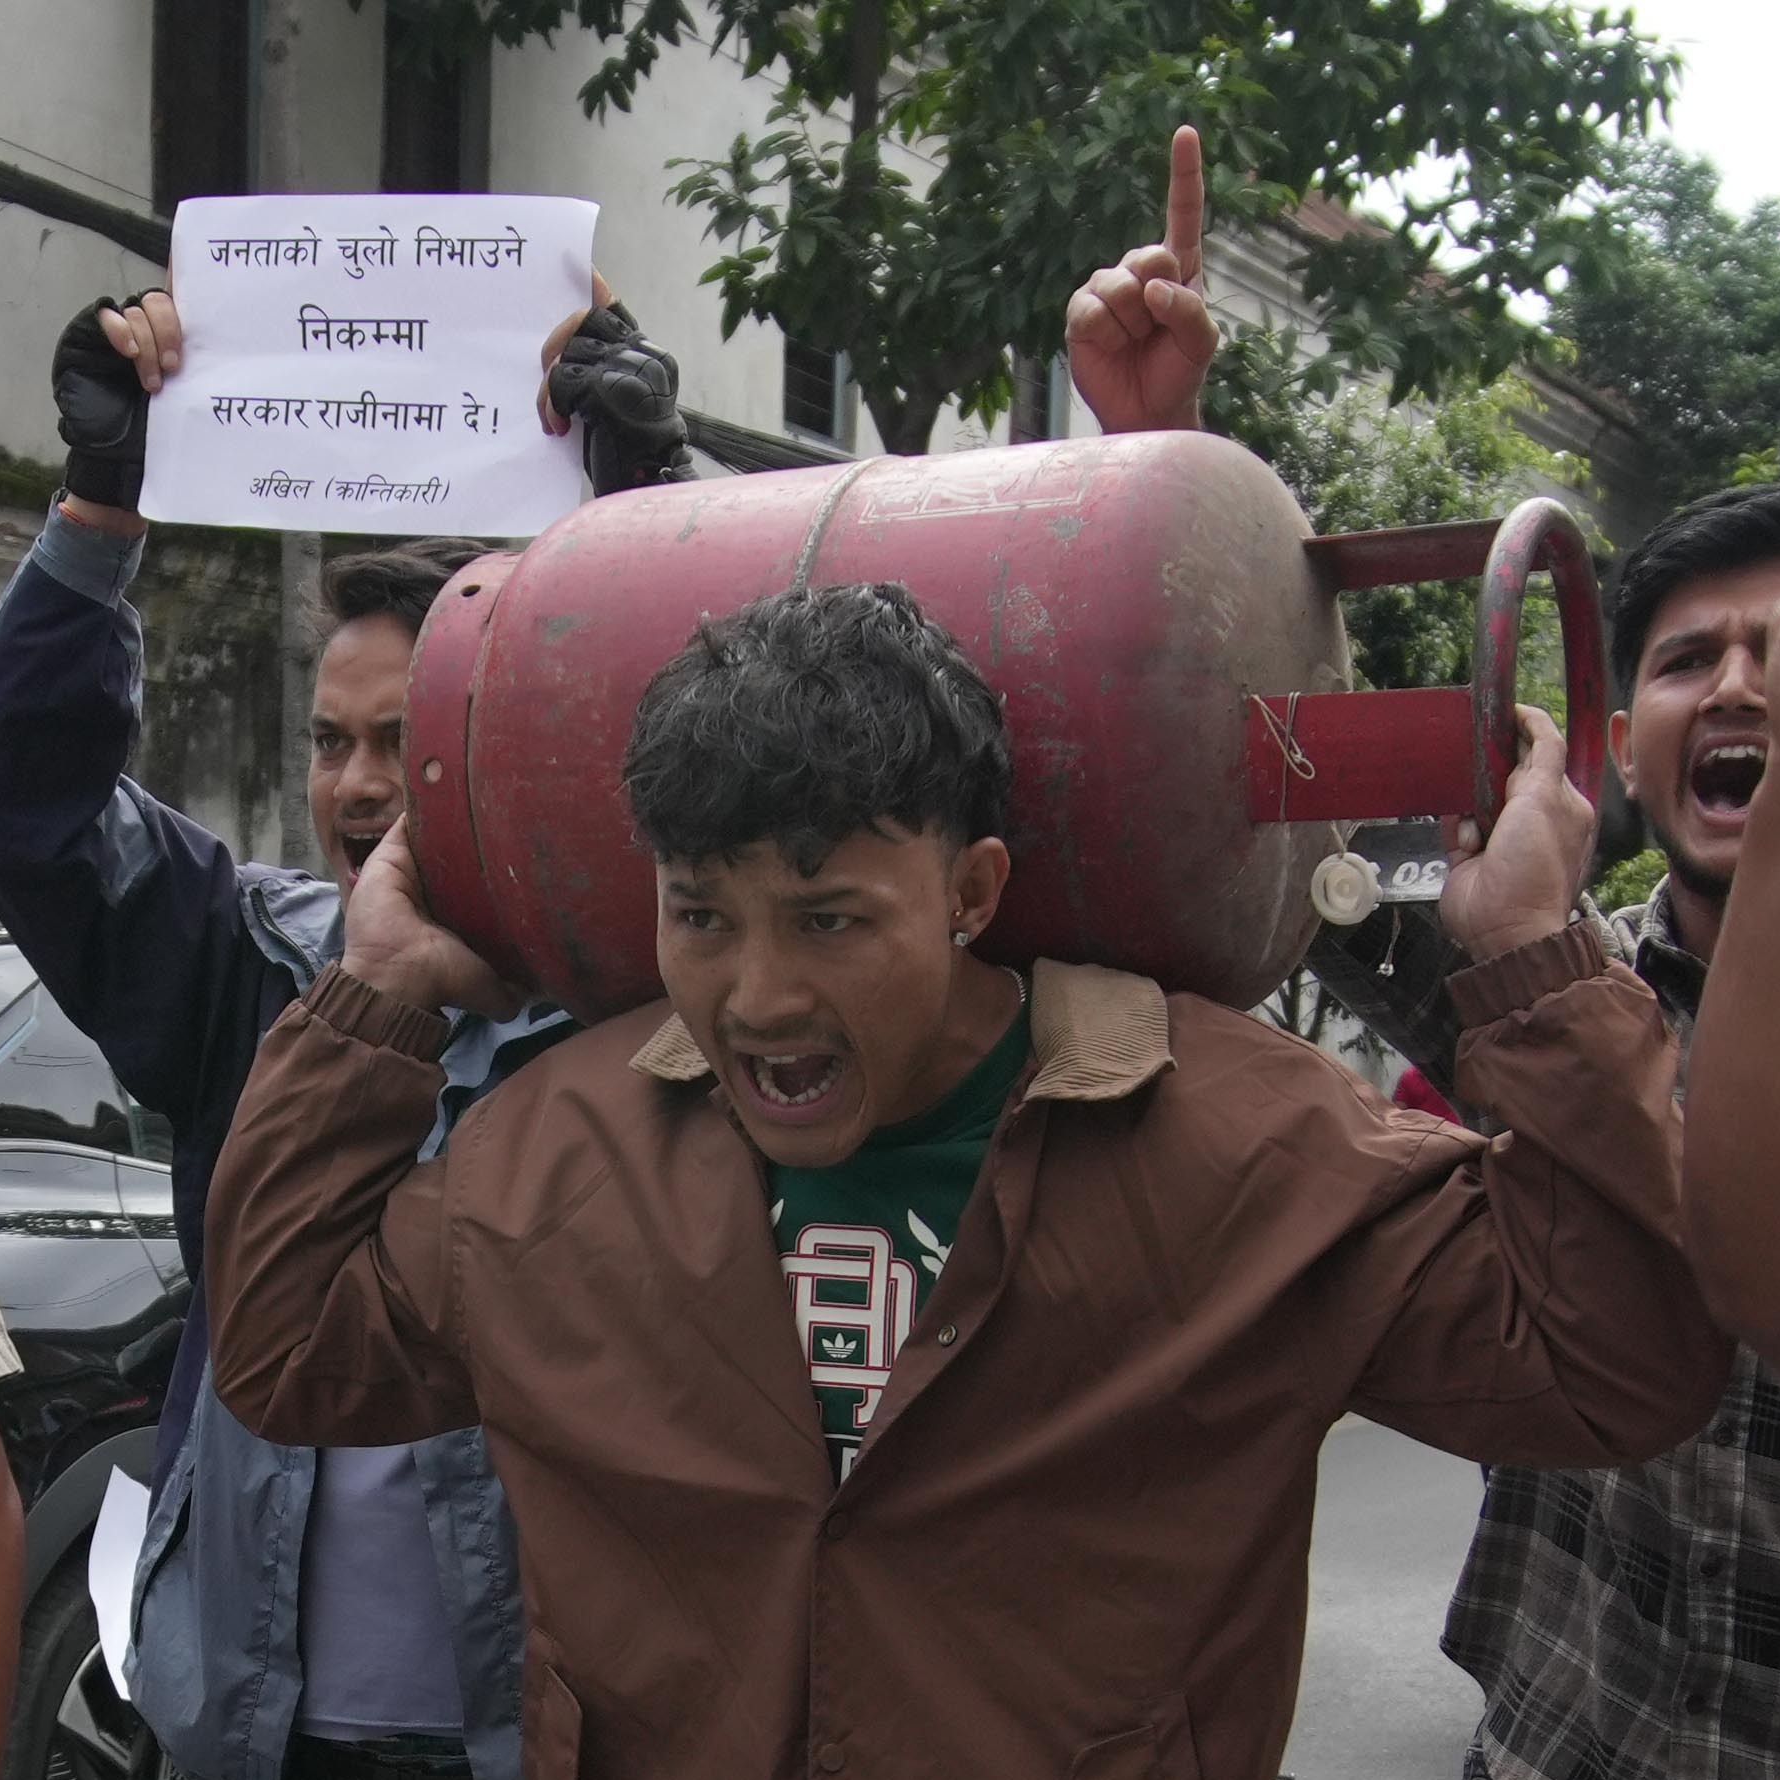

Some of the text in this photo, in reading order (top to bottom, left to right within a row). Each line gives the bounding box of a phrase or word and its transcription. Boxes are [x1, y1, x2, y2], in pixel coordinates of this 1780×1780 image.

[208, 226, 527, 280] जनताको चुलो निभाउने
[298, 304, 429, 352] निकम्मा
[211, 395, 312, 429] सरकार
[317, 391, 447, 432] राजीनामा
[249, 471, 451, 505] अखिल (क्रान्तिकारी)
